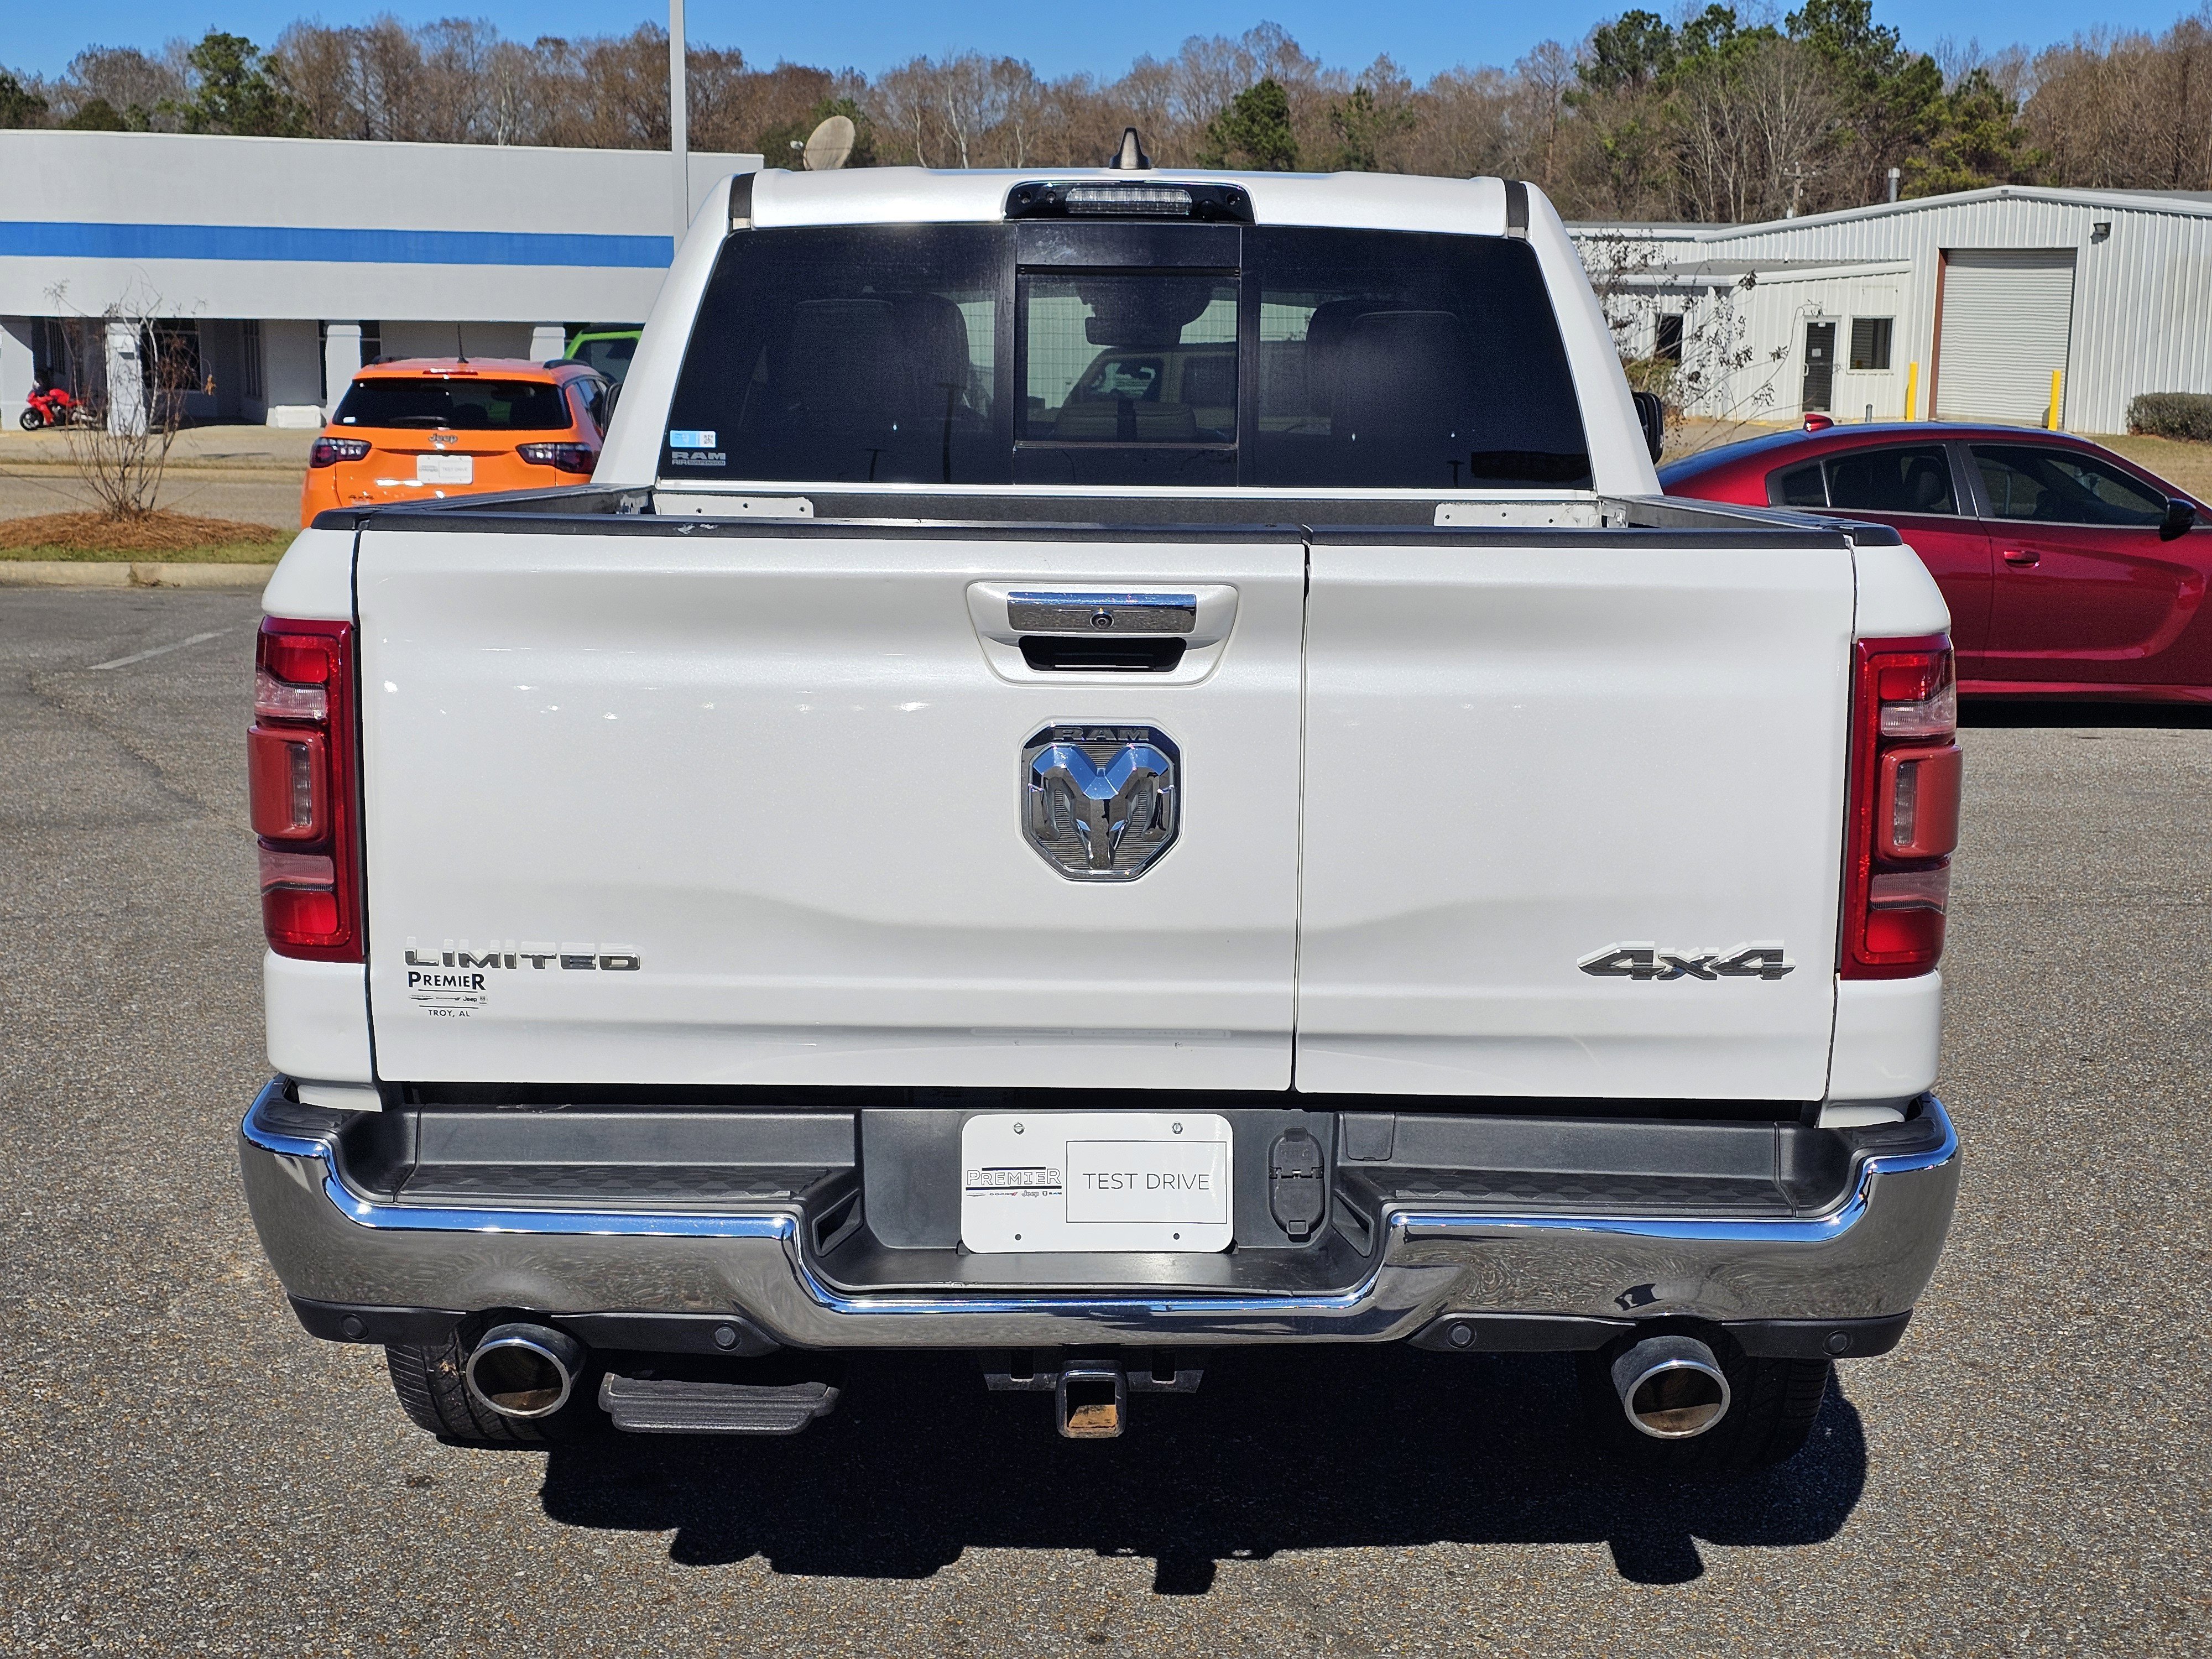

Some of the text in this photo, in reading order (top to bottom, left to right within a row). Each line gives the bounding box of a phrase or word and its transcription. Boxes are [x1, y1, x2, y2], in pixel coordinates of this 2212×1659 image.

[428, 433, 458, 444] Jeep
[672, 451, 726, 460] RAM
[1053, 727, 1149, 741] RAM
[404, 946, 641, 971] LIMITED
[408, 971, 487, 990] PREMIER
[428, 1009, 455, 1018] TROY,
[967, 1168, 1062, 1186] PREMIER
[1082, 1173, 1211, 1191] TEST DRIVE
